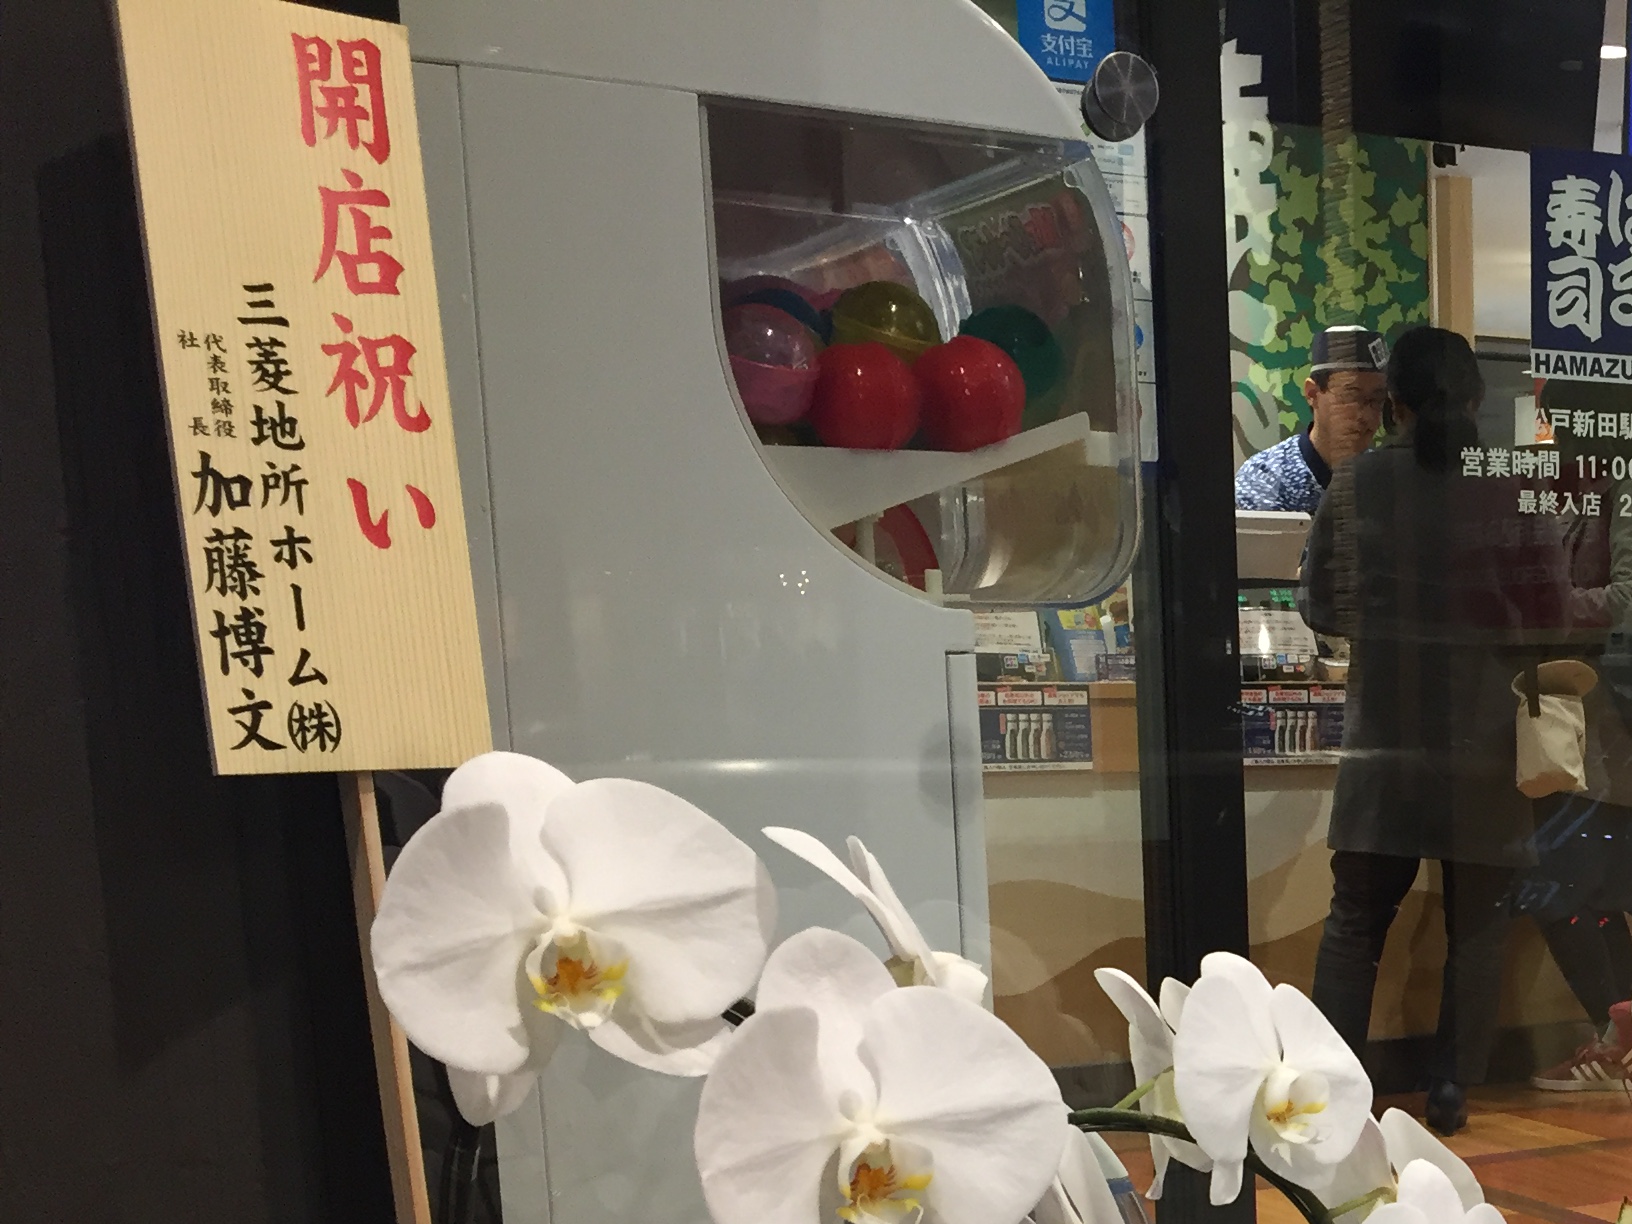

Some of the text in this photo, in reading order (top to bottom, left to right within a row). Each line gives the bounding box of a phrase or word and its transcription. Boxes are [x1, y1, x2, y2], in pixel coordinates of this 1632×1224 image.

[1041, 33, 1093, 58] 支付宝
[1046, 56, 1089, 69] ALIPAY
[291, 32, 436, 549] 開店祝い
[204, 333, 237, 438] 代表取締役
[1460, 446, 1560, 480] 営業時間
[1518, 489, 1602, 517] 最終入店
[191, 451, 287, 752] 加藤博文
